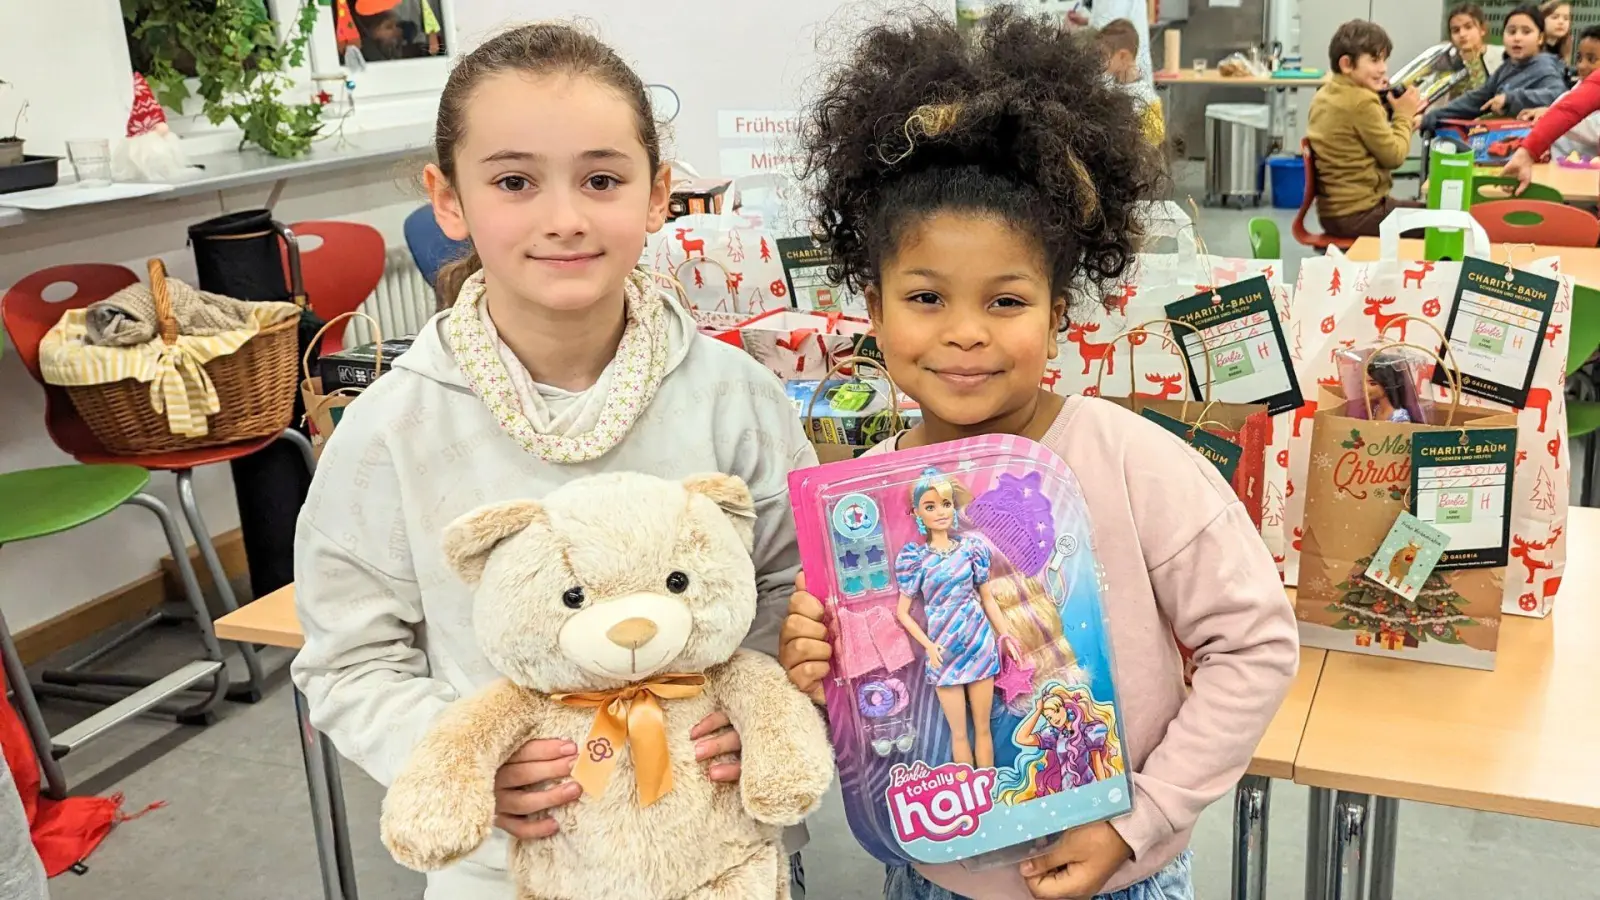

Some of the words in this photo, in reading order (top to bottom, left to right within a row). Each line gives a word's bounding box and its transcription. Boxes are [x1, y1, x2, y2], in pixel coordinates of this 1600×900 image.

[735, 116, 801, 134] Frühstü
[1468, 271, 1548, 301] CHARITY-BAUM
[1178, 291, 1262, 324] CHARITY-BAUM
[1257, 341, 1270, 360] H
[1512, 334, 1523, 350] H
[861, 348, 882, 359] CHA
[1215, 350, 1244, 368] Barbie
[1471, 379, 1498, 392] GALERIA
[1420, 444, 1507, 456] CHARITY-BAUM
[1333, 451, 1412, 500] Christ
[1438, 492, 1468, 508] Barbie
[1480, 492, 1491, 509] H
[1449, 552, 1478, 560] GALERIA
[893, 763, 931, 788] Barbie
[906, 773, 954, 798] totally
[894, 775, 990, 836] hair
